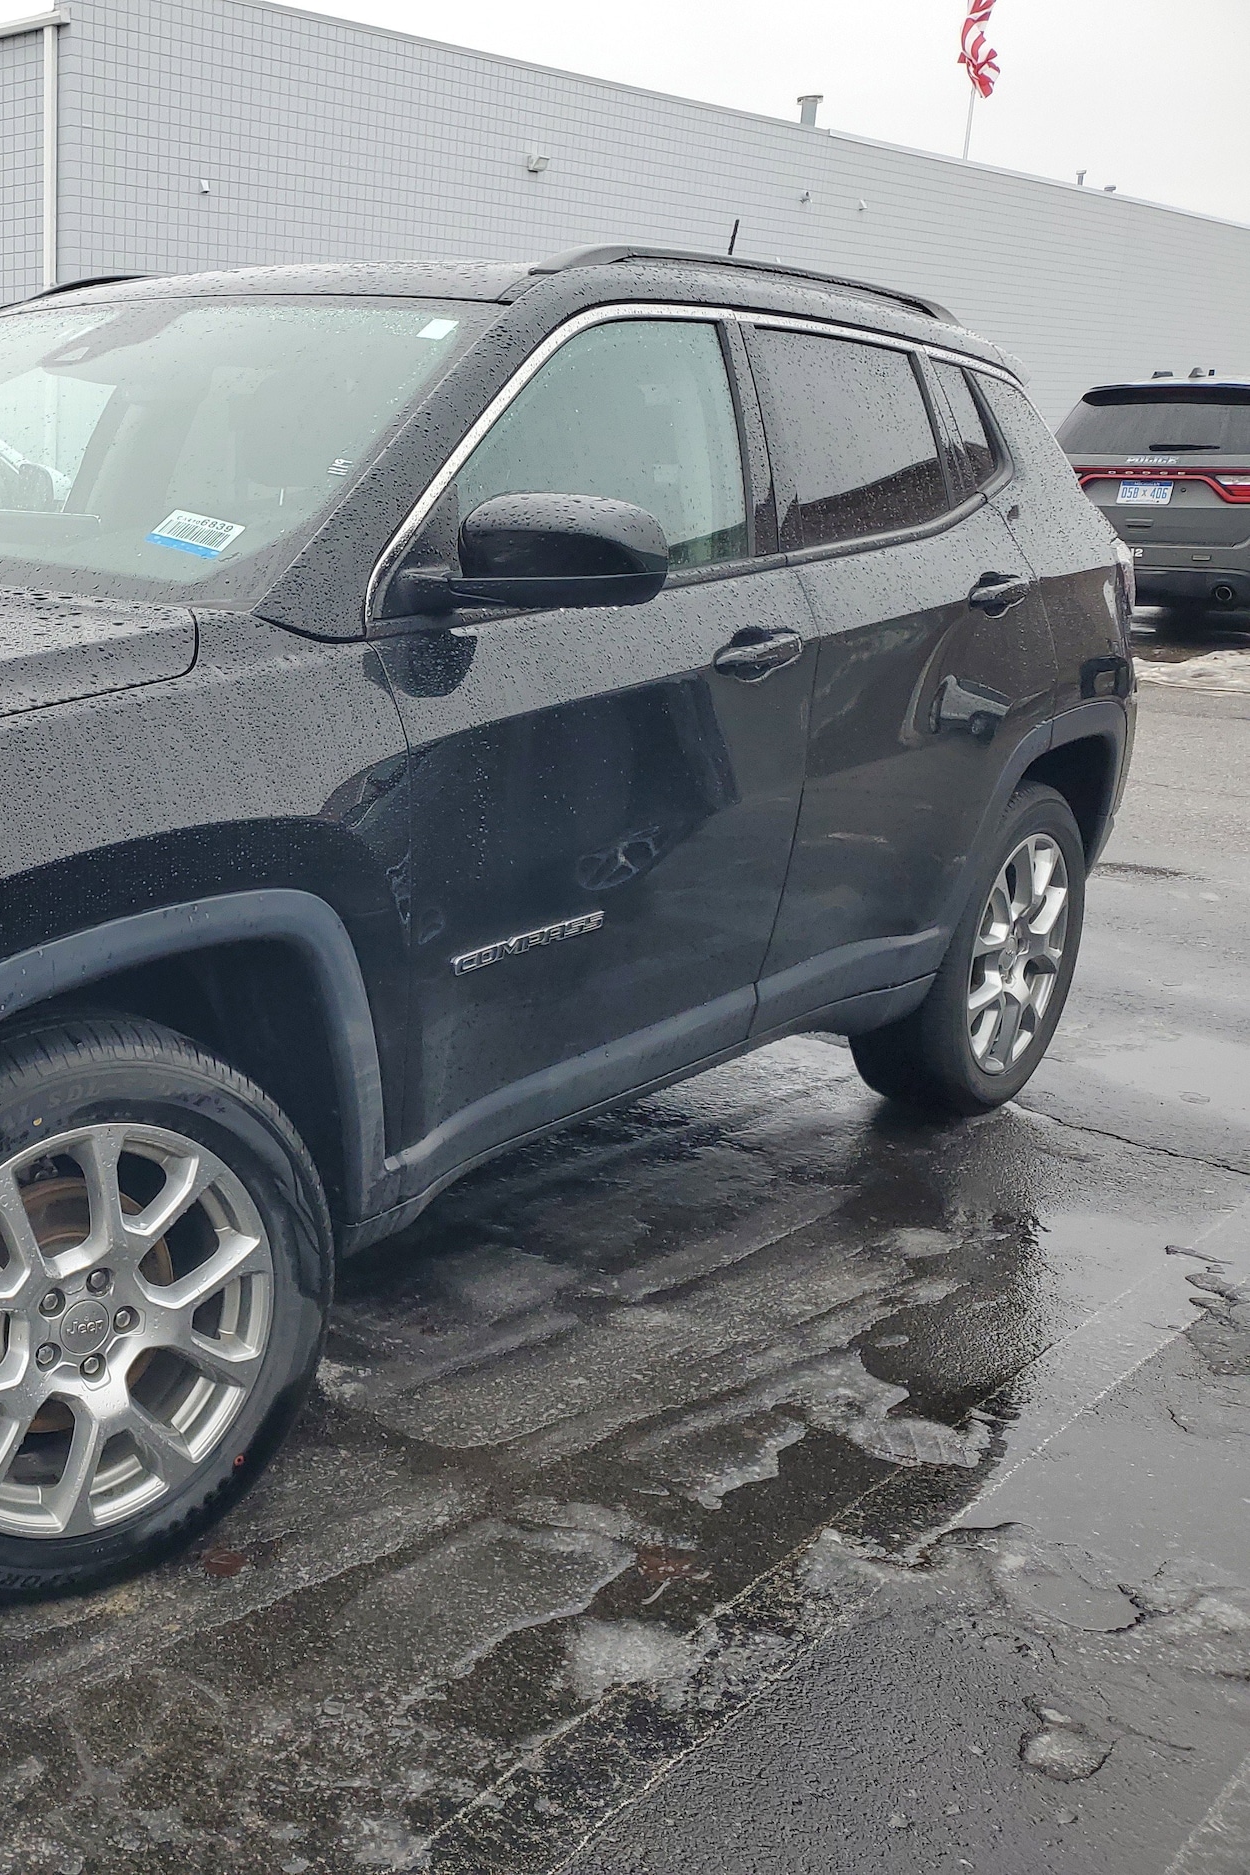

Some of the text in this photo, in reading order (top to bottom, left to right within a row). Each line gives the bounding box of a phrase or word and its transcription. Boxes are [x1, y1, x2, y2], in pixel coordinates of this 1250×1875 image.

[1149, 487, 1169, 500] 406
[450, 910, 606, 977] COMPASS
[66, 1319, 104, 1335] Jeep
